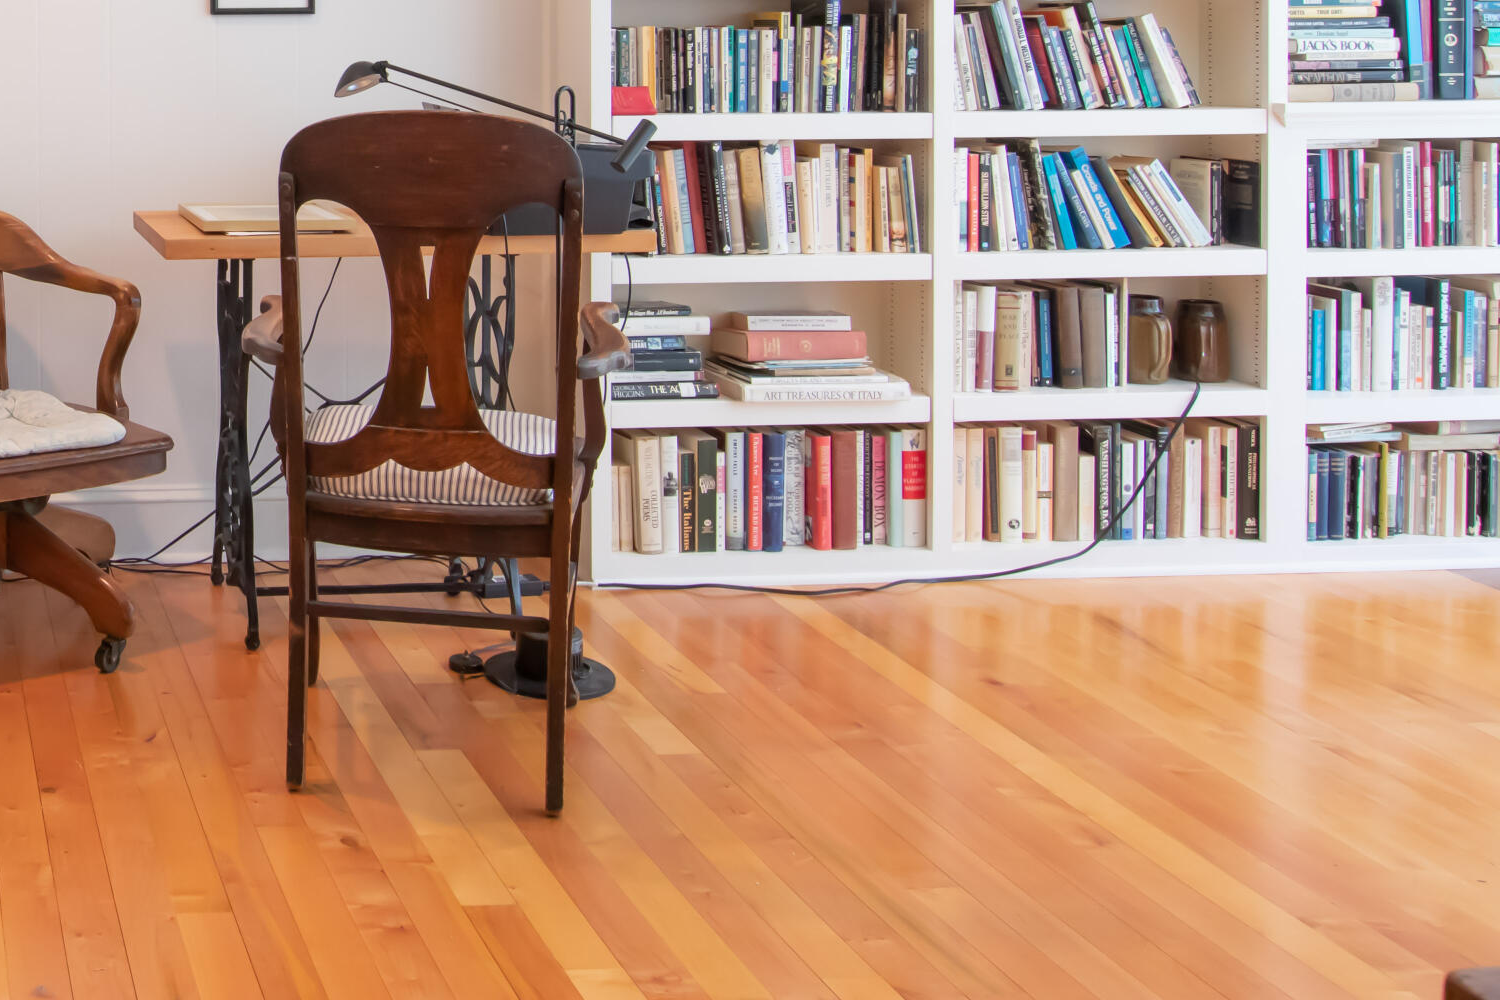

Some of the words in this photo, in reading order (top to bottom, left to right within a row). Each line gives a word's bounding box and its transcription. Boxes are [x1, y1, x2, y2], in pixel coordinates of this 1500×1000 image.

[1300, 39, 1338, 52] JACK'S
[1340, 40, 1375, 51] BOOK
[1019, 44, 1033, 73] WESTLAKE
[1081, 164, 1098, 193] Crowds
[1095, 193, 1106, 207] and
[980, 210, 989, 227] STEW
[1100, 207, 1118, 231] Power
[613, 390, 645, 398] HIGGINS
[650, 384, 668, 394] THE
[764, 391, 786, 401] ART
[787, 391, 841, 401] TREASURES
[842, 391, 856, 400] OF
[857, 390, 884, 400] ITALY
[874, 460, 885, 500] DEMON
[1099, 439, 1109, 509] WASHINGTON,
[642, 498, 651, 522] POEMS
[650, 489, 659, 529] COLLECTED
[683, 488, 693, 510] The
[874, 504, 885, 528] BOX
[683, 511, 693, 551] Italians
